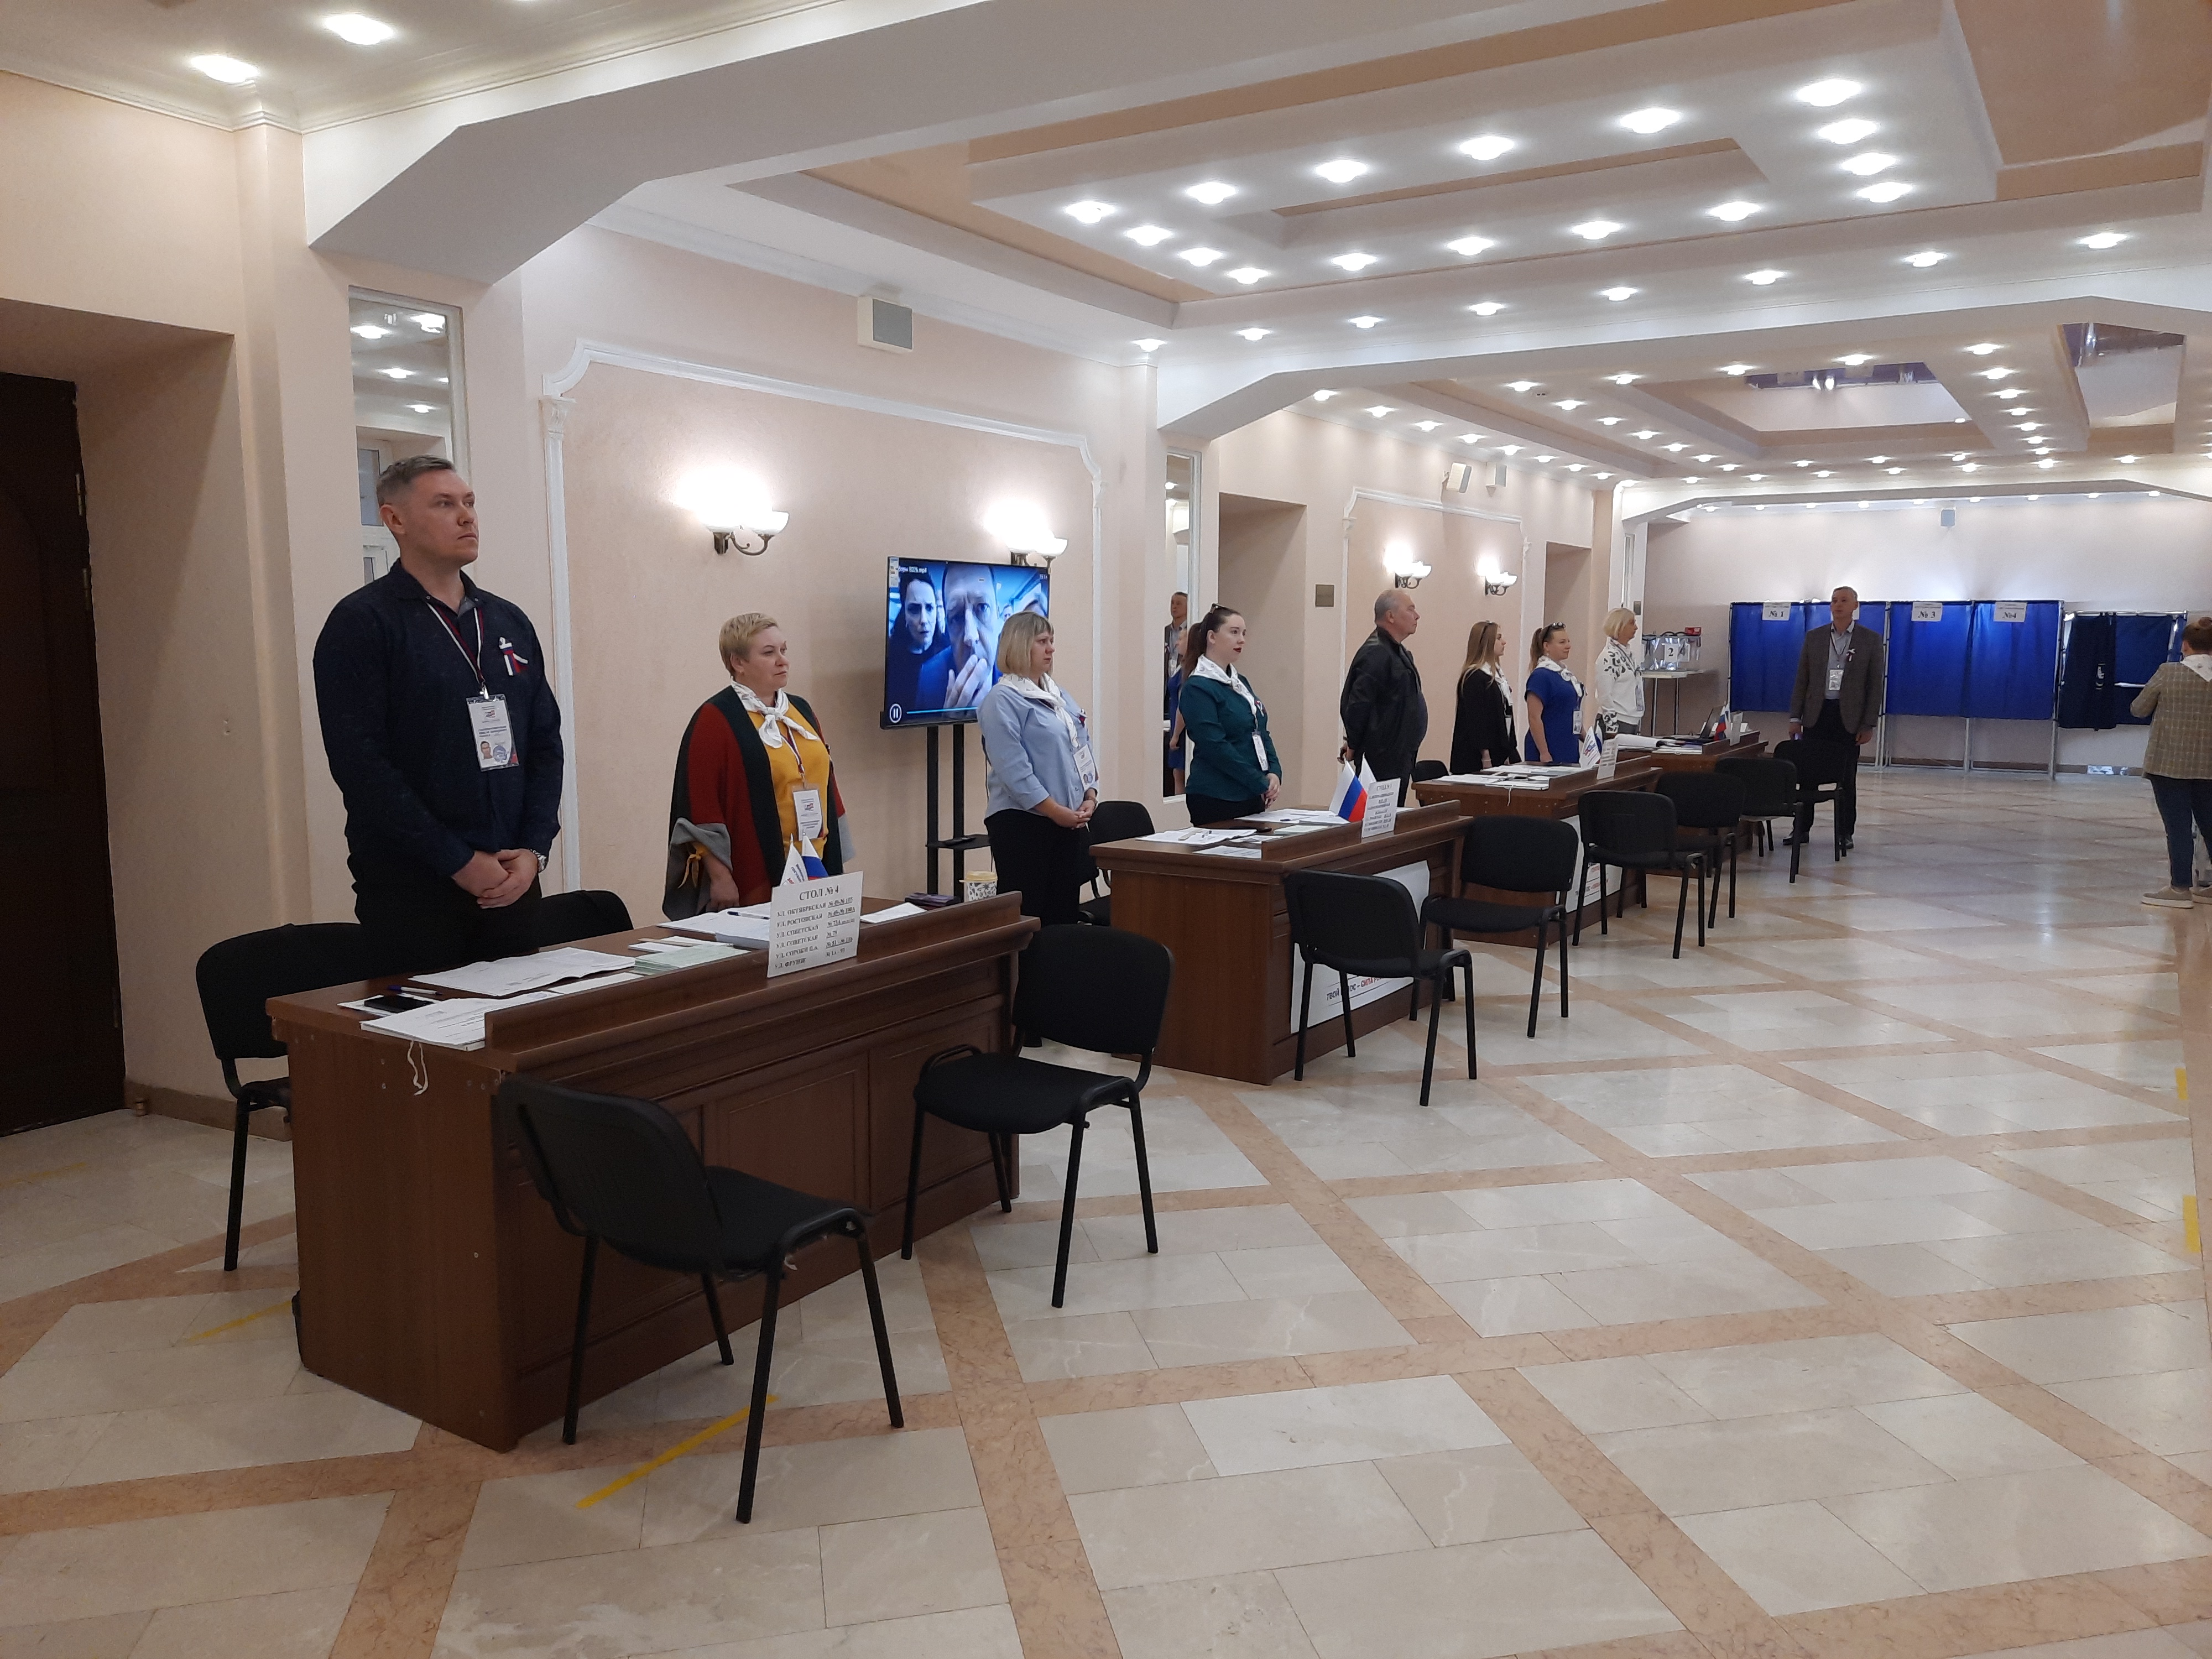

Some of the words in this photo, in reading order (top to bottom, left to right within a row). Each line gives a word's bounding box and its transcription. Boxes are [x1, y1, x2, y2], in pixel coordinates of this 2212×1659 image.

[1668, 648, 1674, 656] 2
[800, 888, 823, 900] СТОЛ
[825, 887, 833, 896] №
[835, 885, 839, 893] 4
[786, 924, 818, 936] СОВЕТСКАЯ
[786, 935, 818, 946] СОВЕТСКАЯ
[1327, 988, 1339, 1000] ТВОЙ
